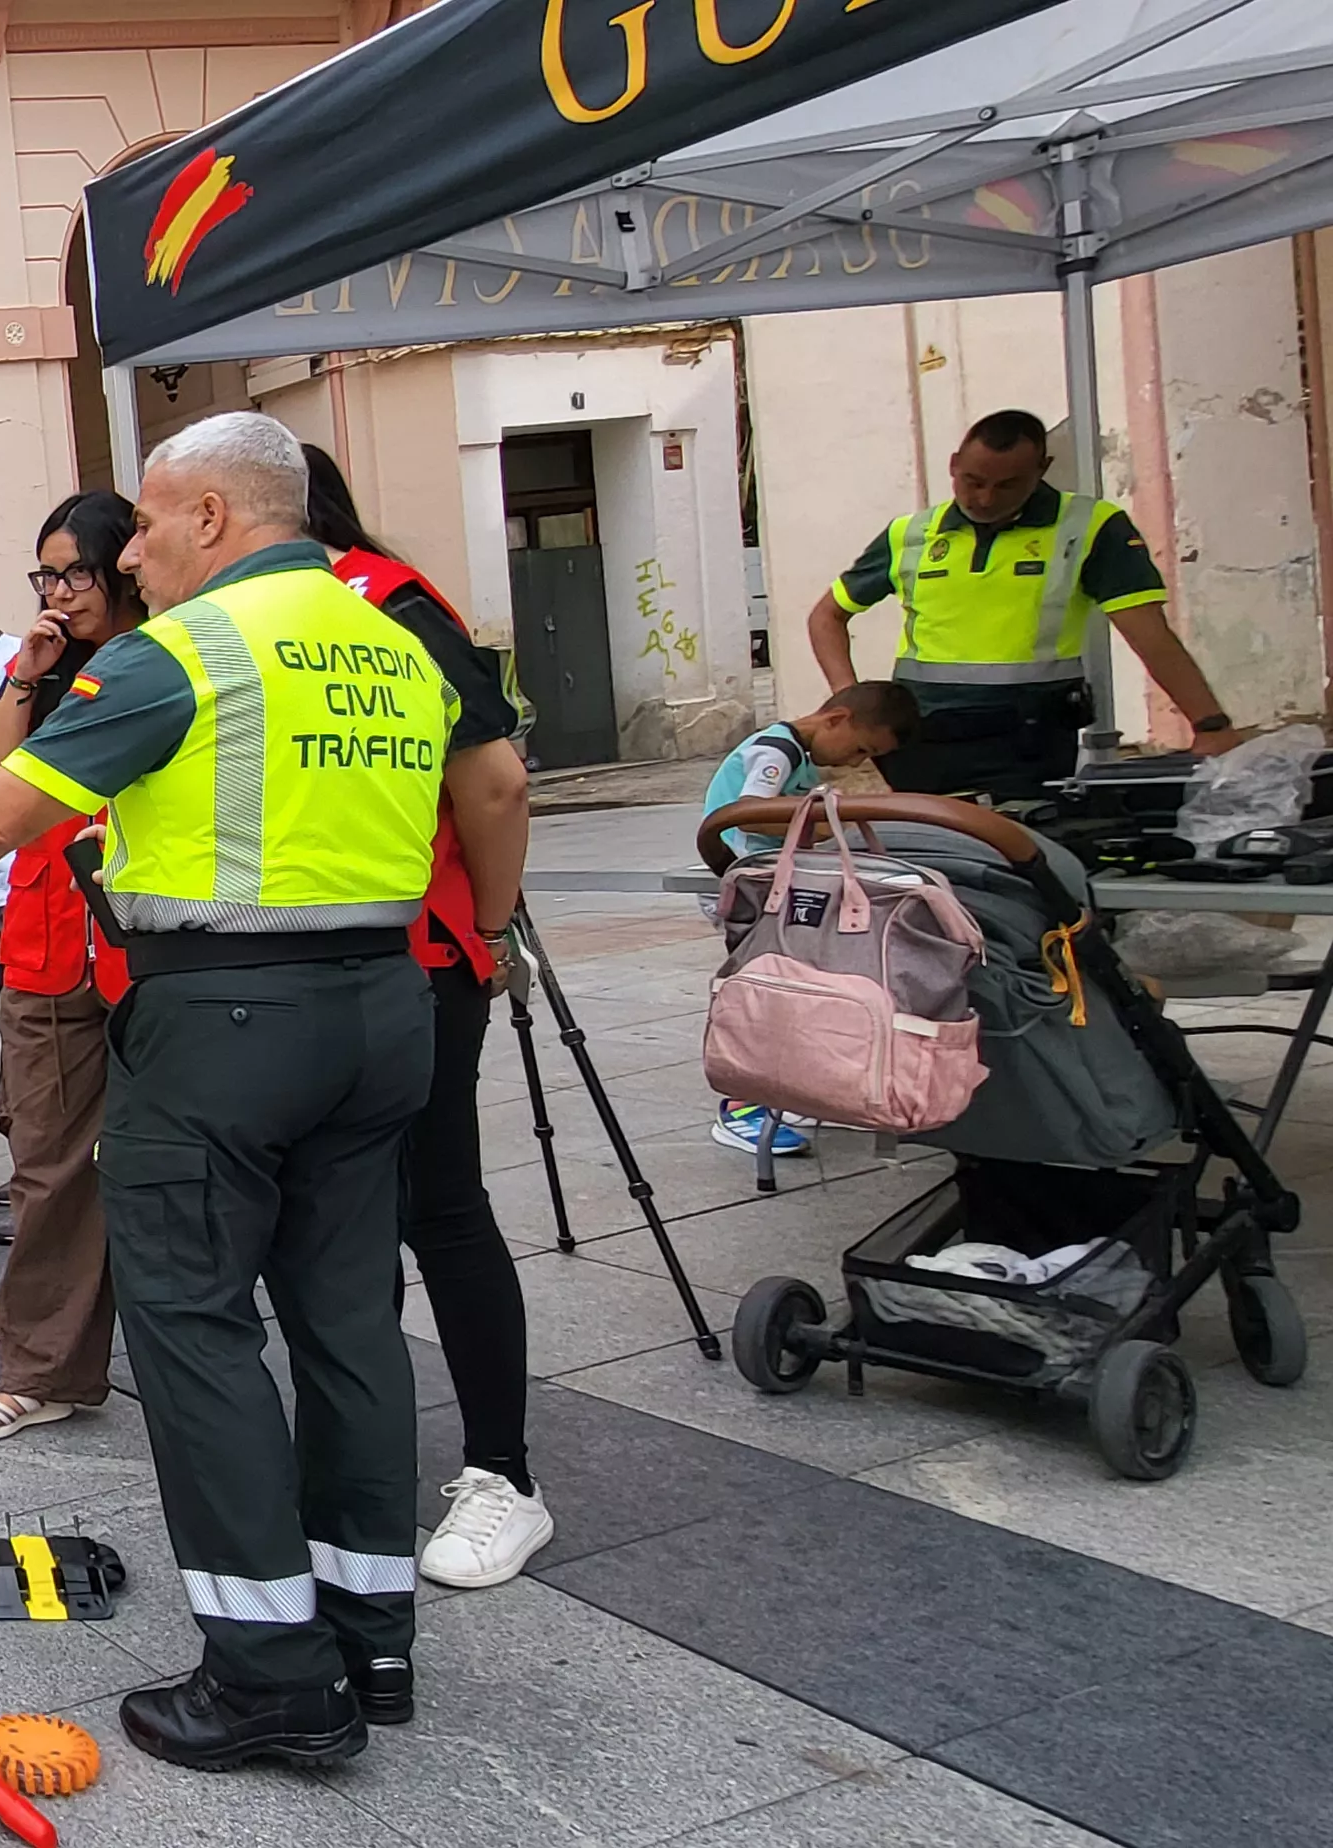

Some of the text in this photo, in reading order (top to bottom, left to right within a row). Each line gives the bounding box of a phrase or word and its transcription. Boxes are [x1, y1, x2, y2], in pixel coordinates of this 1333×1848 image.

[274, 640, 428, 684] GUARDIA
[325, 683, 407, 719] CIVIL
[291, 726, 434, 772] TRÁFICO
